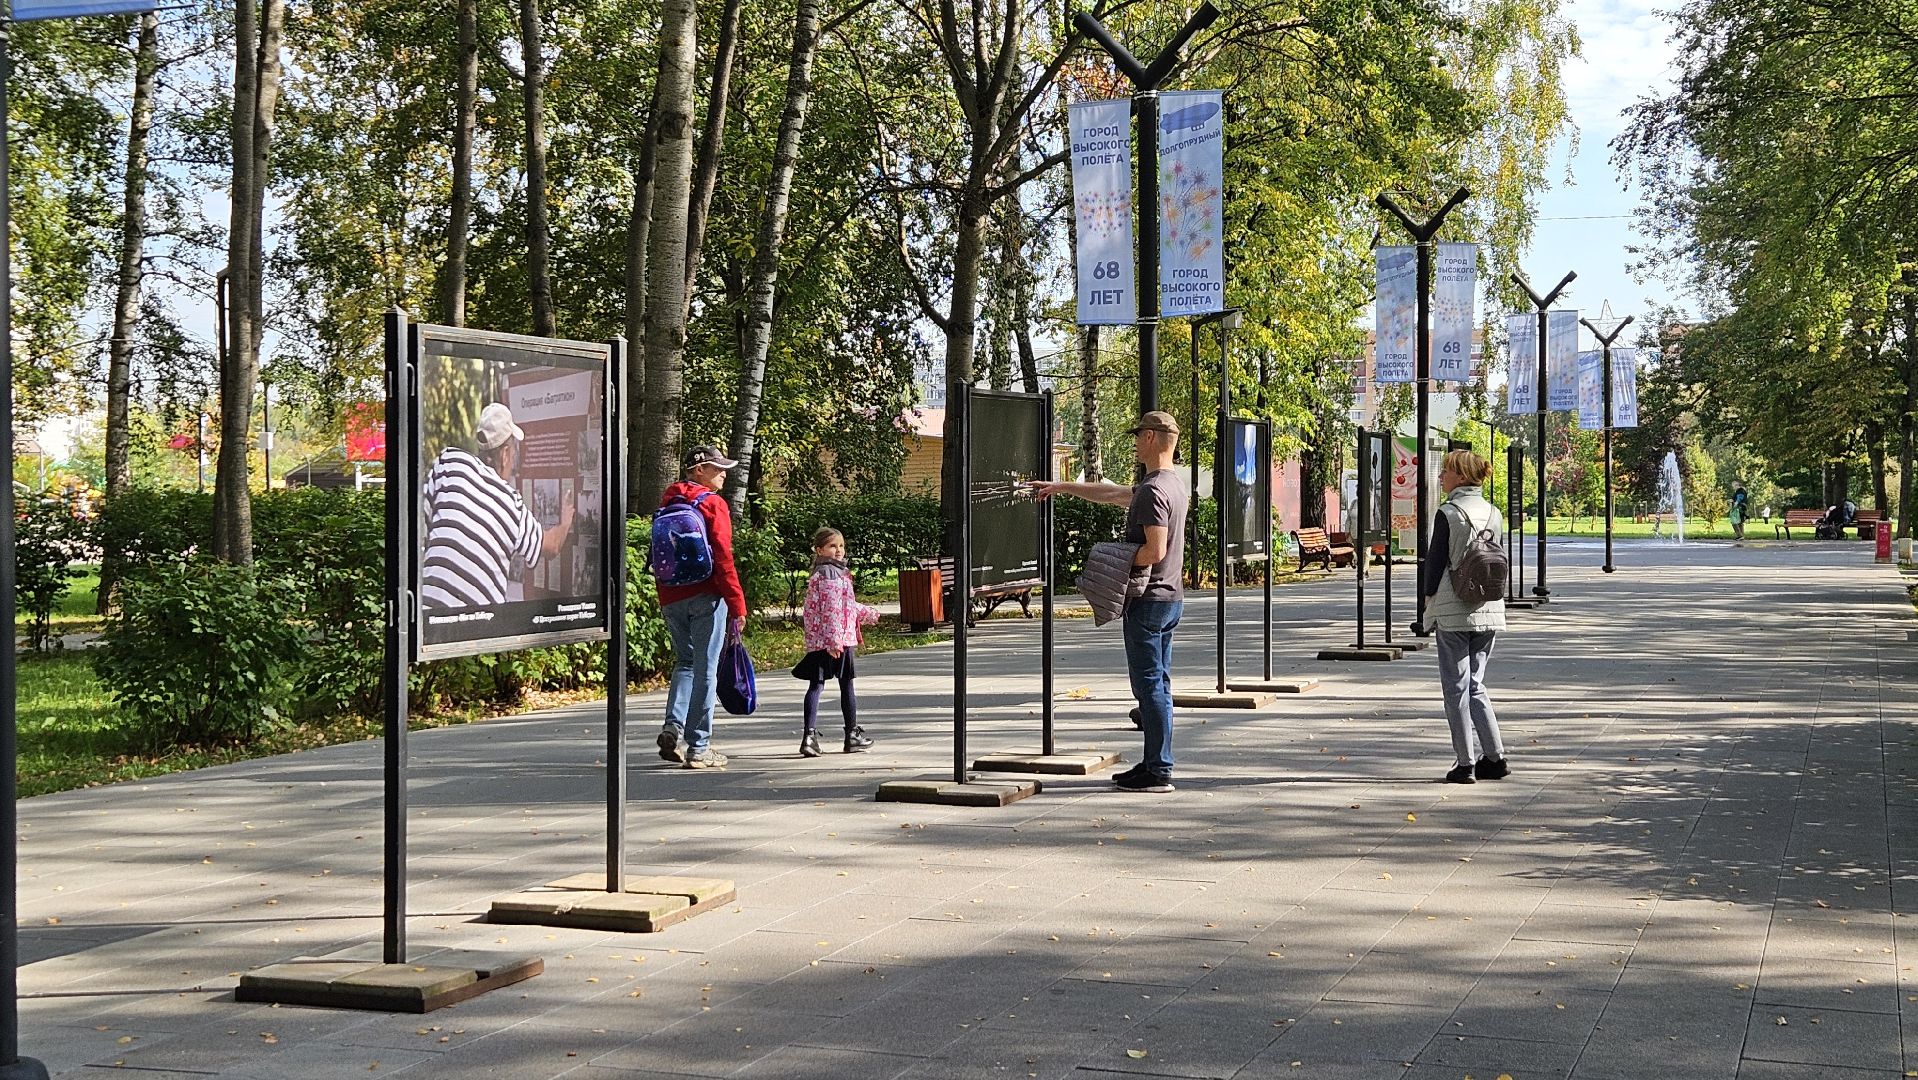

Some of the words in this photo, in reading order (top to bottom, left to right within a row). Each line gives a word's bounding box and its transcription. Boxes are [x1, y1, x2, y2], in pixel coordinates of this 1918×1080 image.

[1083, 125, 1119, 139] ГОРОД
[1073, 138, 1130, 153] ВЫСОКОГО
[1160, 128, 1221, 156] ДОЛГОПРУДНЫЙ
[1081, 152, 1124, 166] ПОЛЁТА
[1093, 260, 1120, 280] 68
[1172, 268, 1209, 279] ГОРОД
[1162, 281, 1221, 293] ВЫСОКОГО
[1089, 289, 1124, 306] ЛЕТ
[1169, 293, 1212, 307] ПОЛЁТА
[1442, 341, 1461, 353] 68
[1377, 361, 1415, 369] ВЫСОКОГО
[1438, 359, 1463, 369] ЛЕТ
[1515, 385, 1529, 394] 68
[1513, 398, 1531, 406] ЛЕТ
[694, 451, 706, 462] 91
